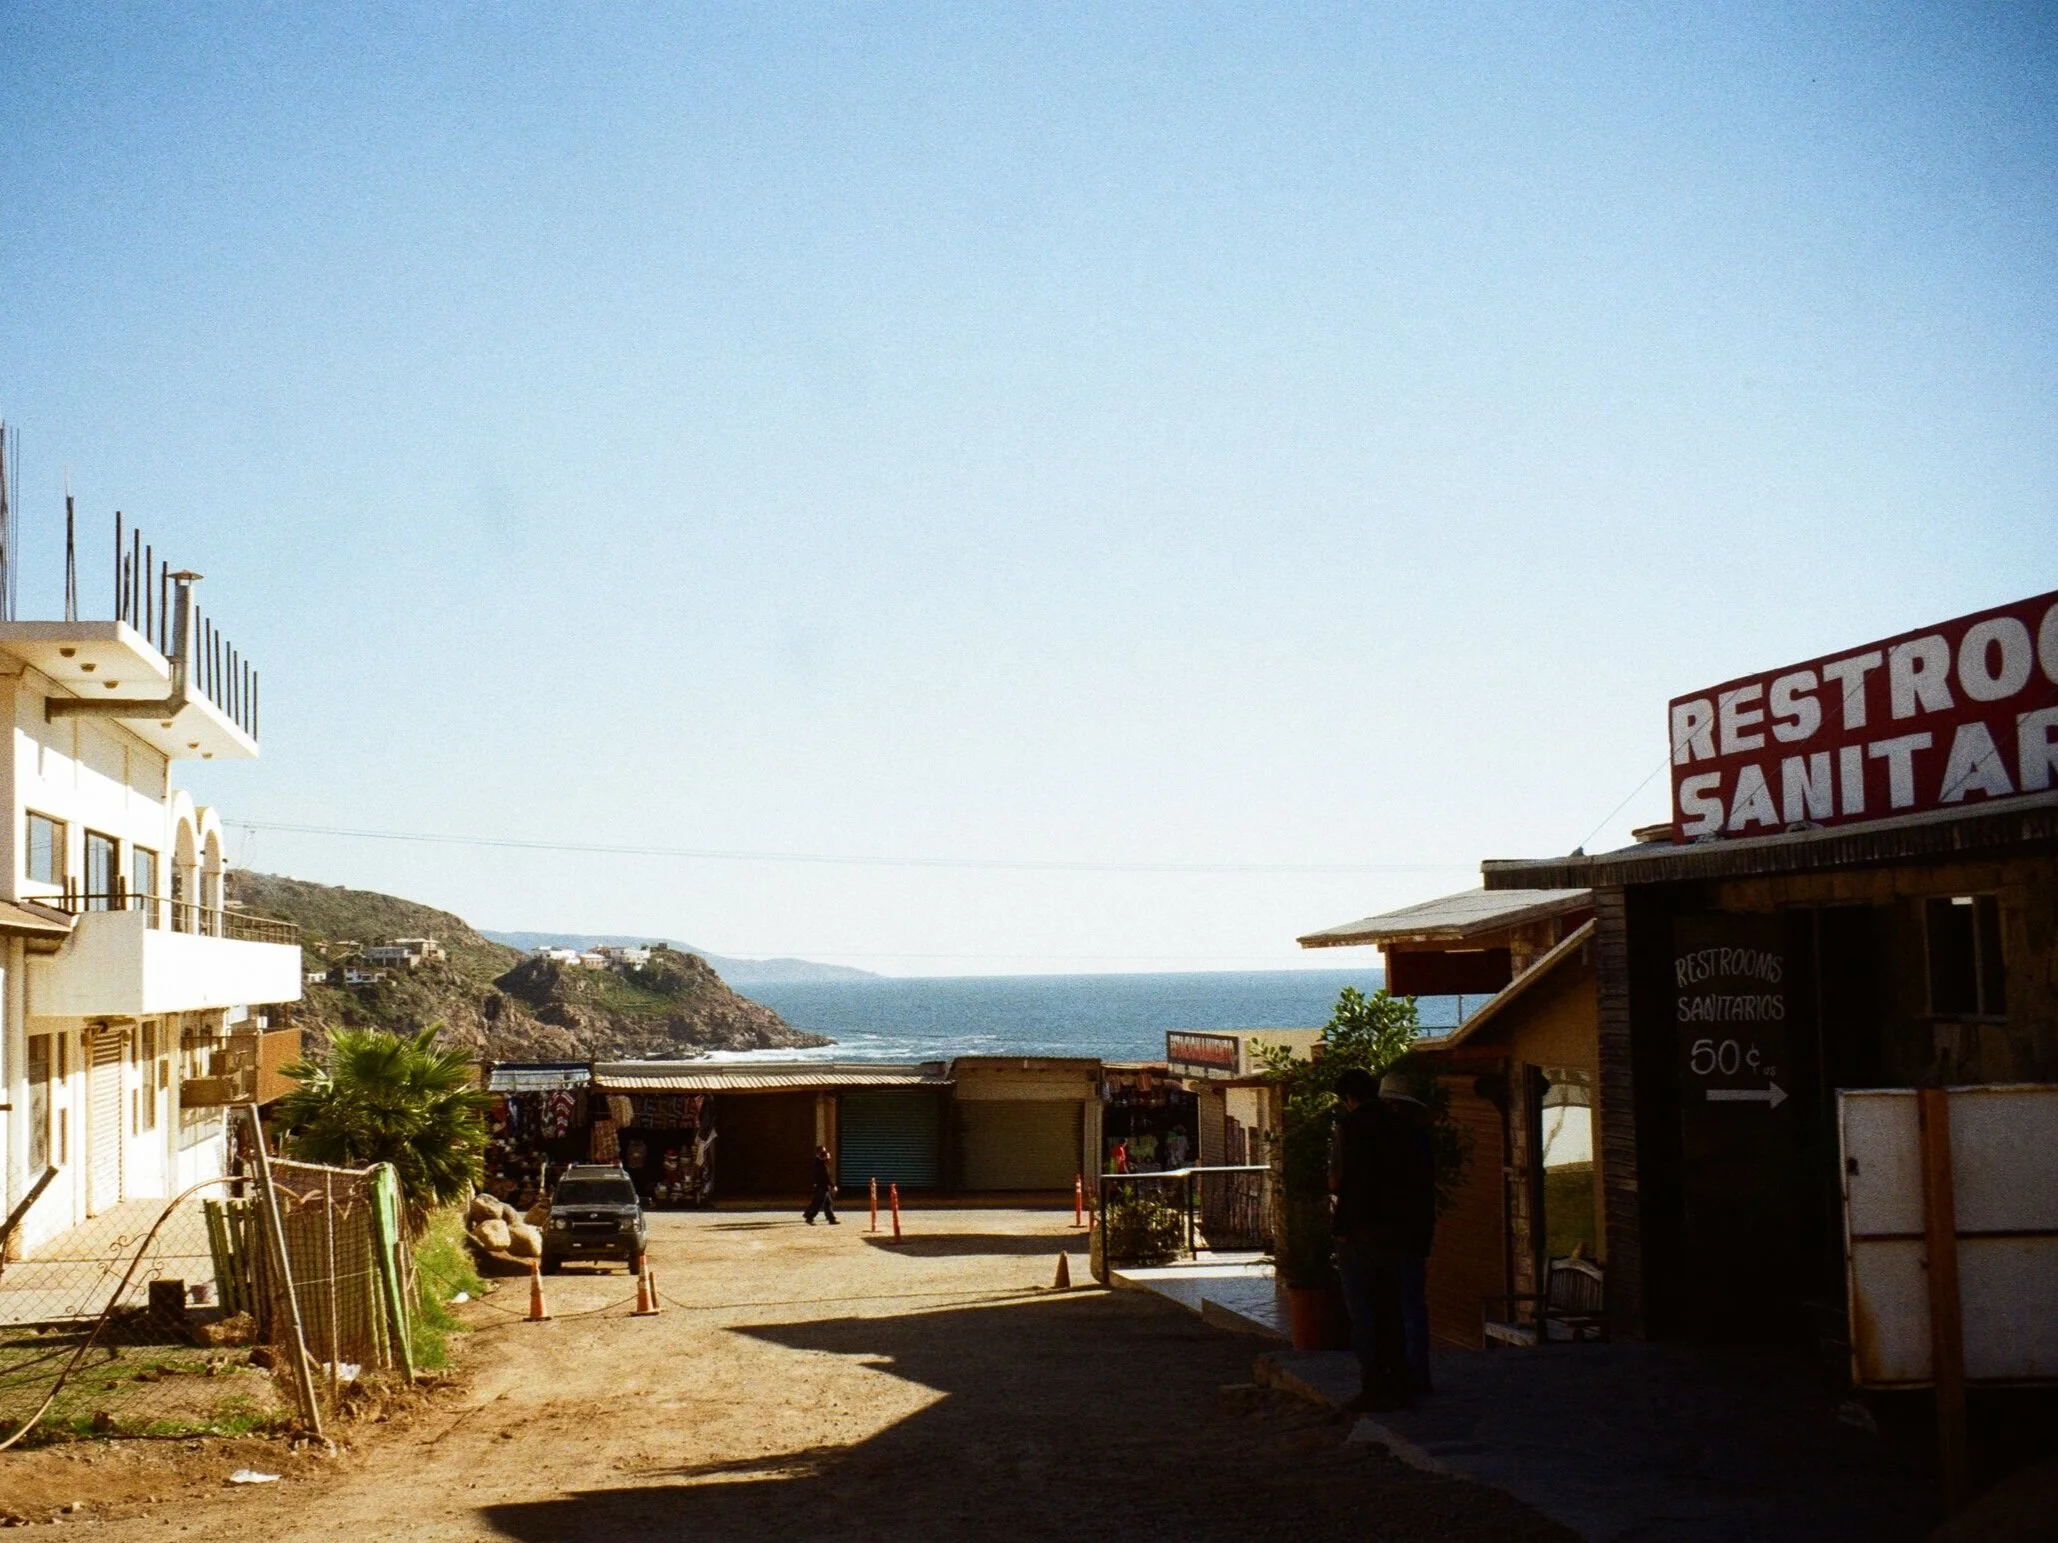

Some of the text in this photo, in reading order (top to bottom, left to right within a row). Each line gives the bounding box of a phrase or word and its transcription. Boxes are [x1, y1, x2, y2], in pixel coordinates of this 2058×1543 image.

[1671, 603, 2058, 766] RESTRO
[1674, 947, 1784, 988] RESTROOMS
[1677, 993, 1786, 1022] SANITARIOS
